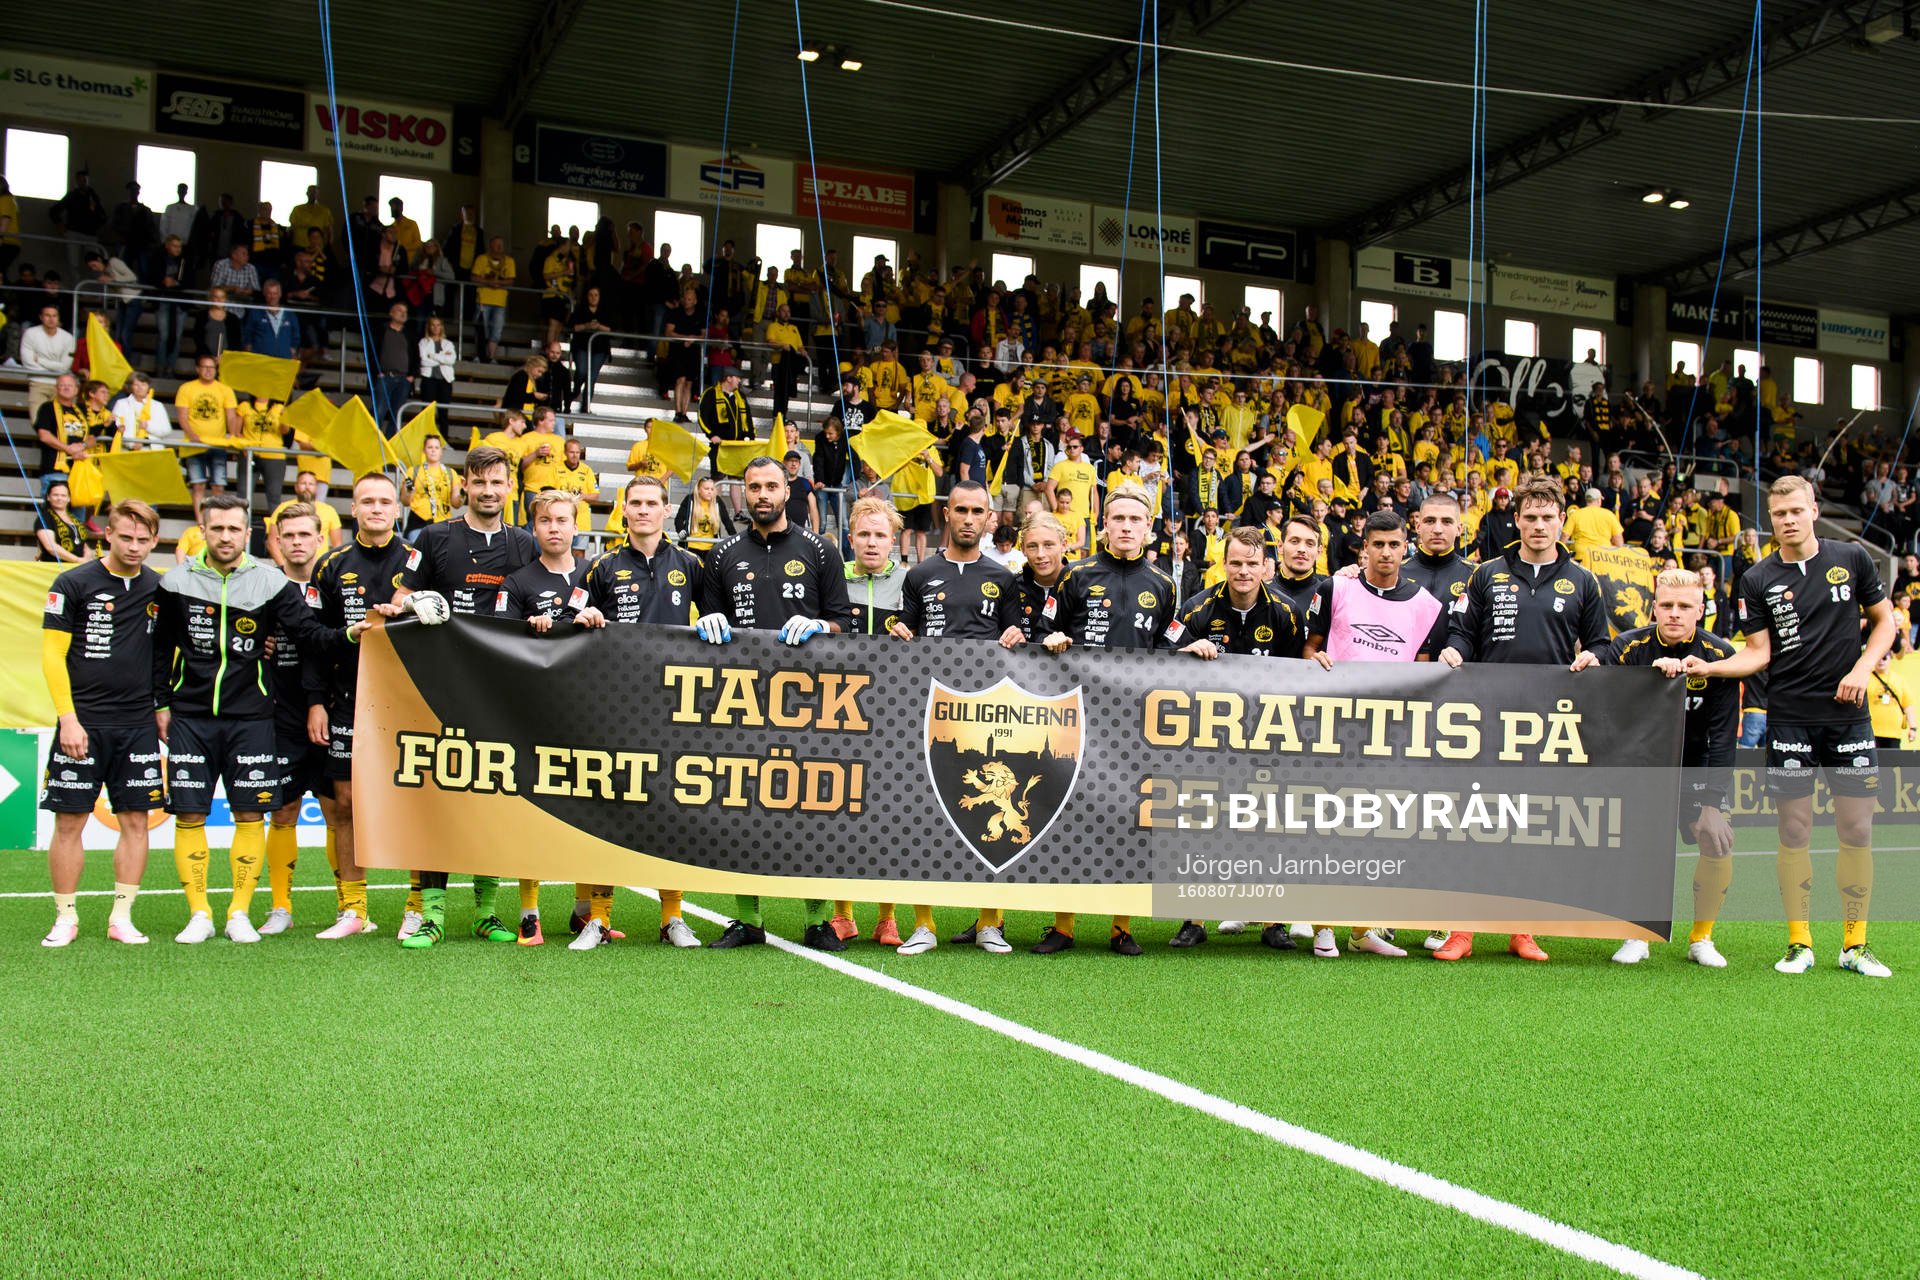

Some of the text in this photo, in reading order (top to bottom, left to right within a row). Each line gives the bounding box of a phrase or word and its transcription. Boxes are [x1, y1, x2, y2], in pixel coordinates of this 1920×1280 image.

[14, 69, 134, 97] SLG thomas
[315, 104, 446, 146] VISKO
[813, 178, 900, 206] PEAB
[1129, 223, 1191, 245] LONDRÉ
[1133, 241, 1188, 255] TEXTLES
[1672, 302, 1719, 322] MAKE
[782, 582, 805, 599] 23
[1493, 593, 1517, 602] ellos
[1830, 584, 1851, 603] 16
[88, 611, 112, 622] ellos
[981, 599, 995, 617] 11
[1087, 608, 1109, 619] ellos
[1772, 603, 1794, 616] ellos
[1134, 612, 1153, 632] 24
[232, 637, 255, 652] 20
[1353, 636, 1399, 656] umbro
[665, 664, 870, 732] TACK
[934, 701, 1077, 727] GULIGANERNA
[994, 728, 1013, 738] 1991
[1144, 689, 1588, 763] GRATTIS PÅ
[398, 728, 864, 813] FÖR ERT STÖD!
